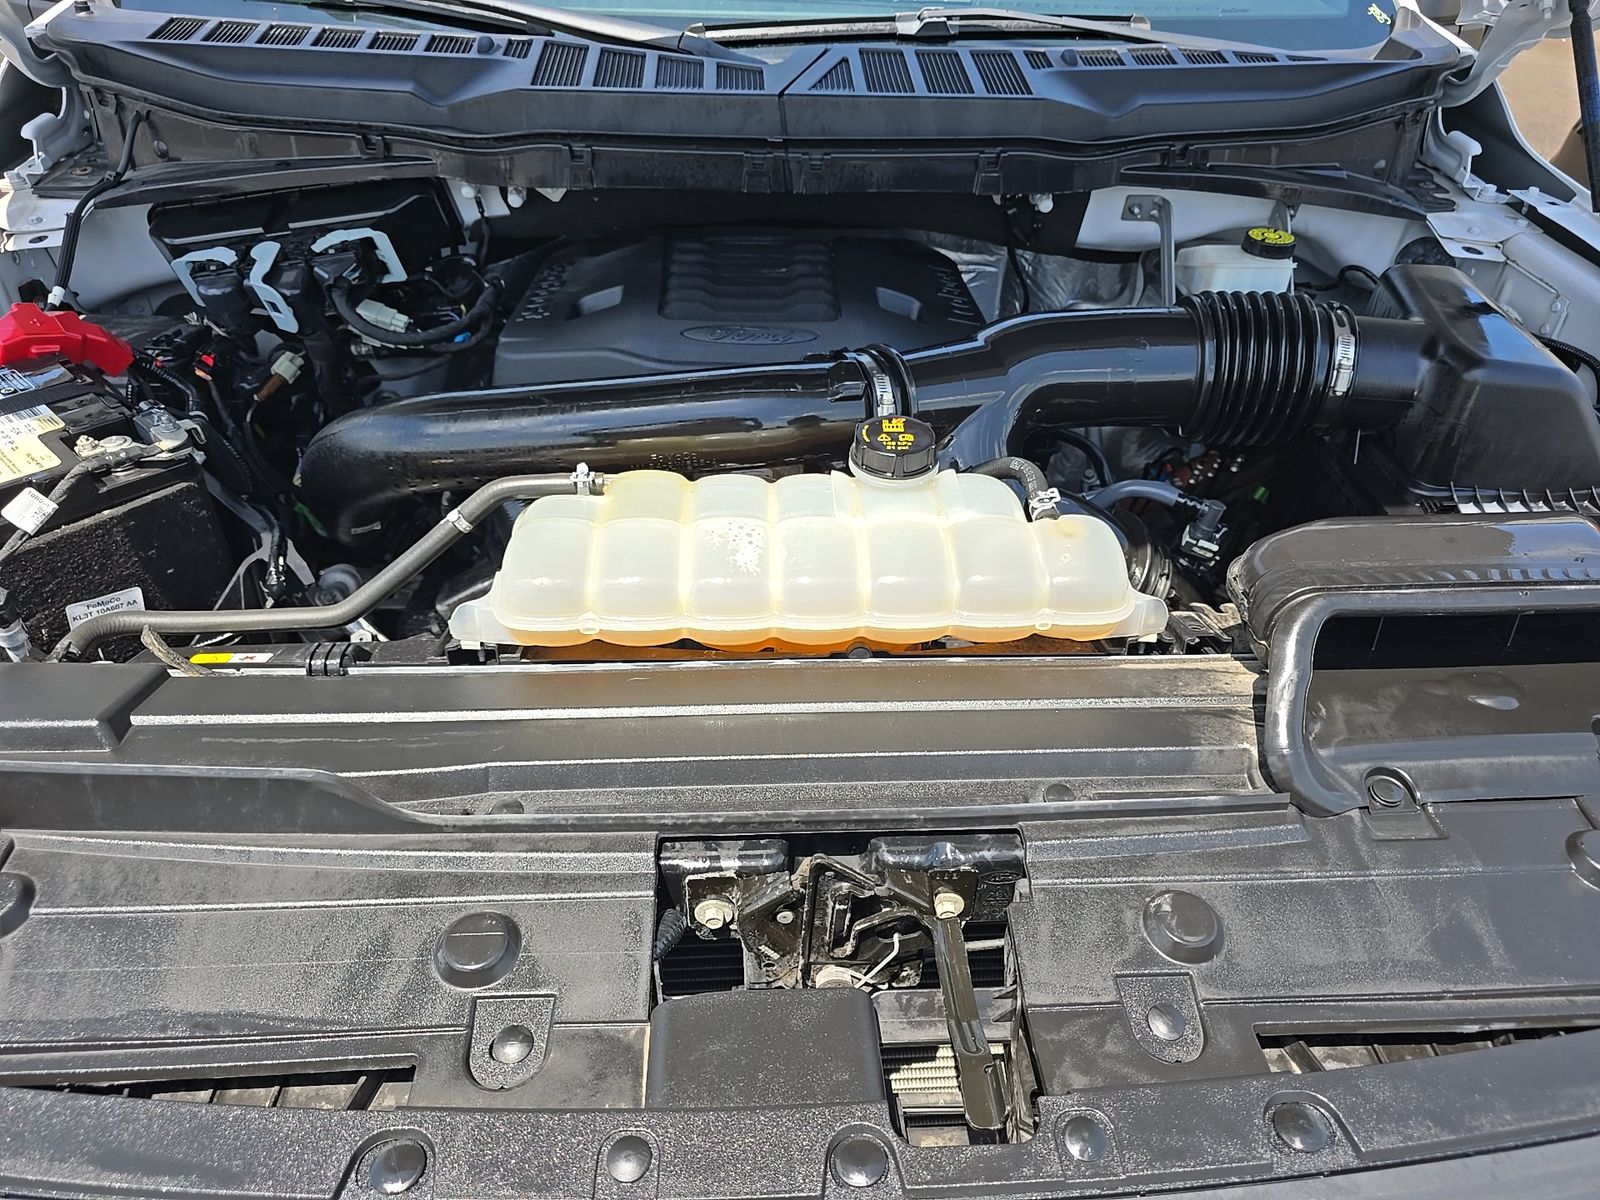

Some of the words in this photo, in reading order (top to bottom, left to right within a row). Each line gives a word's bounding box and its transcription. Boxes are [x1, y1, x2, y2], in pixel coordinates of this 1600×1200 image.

[72, 611, 95, 622] KL3T
[126, 599, 138, 607] AA
[86, 597, 121, 610] FoMoCo
